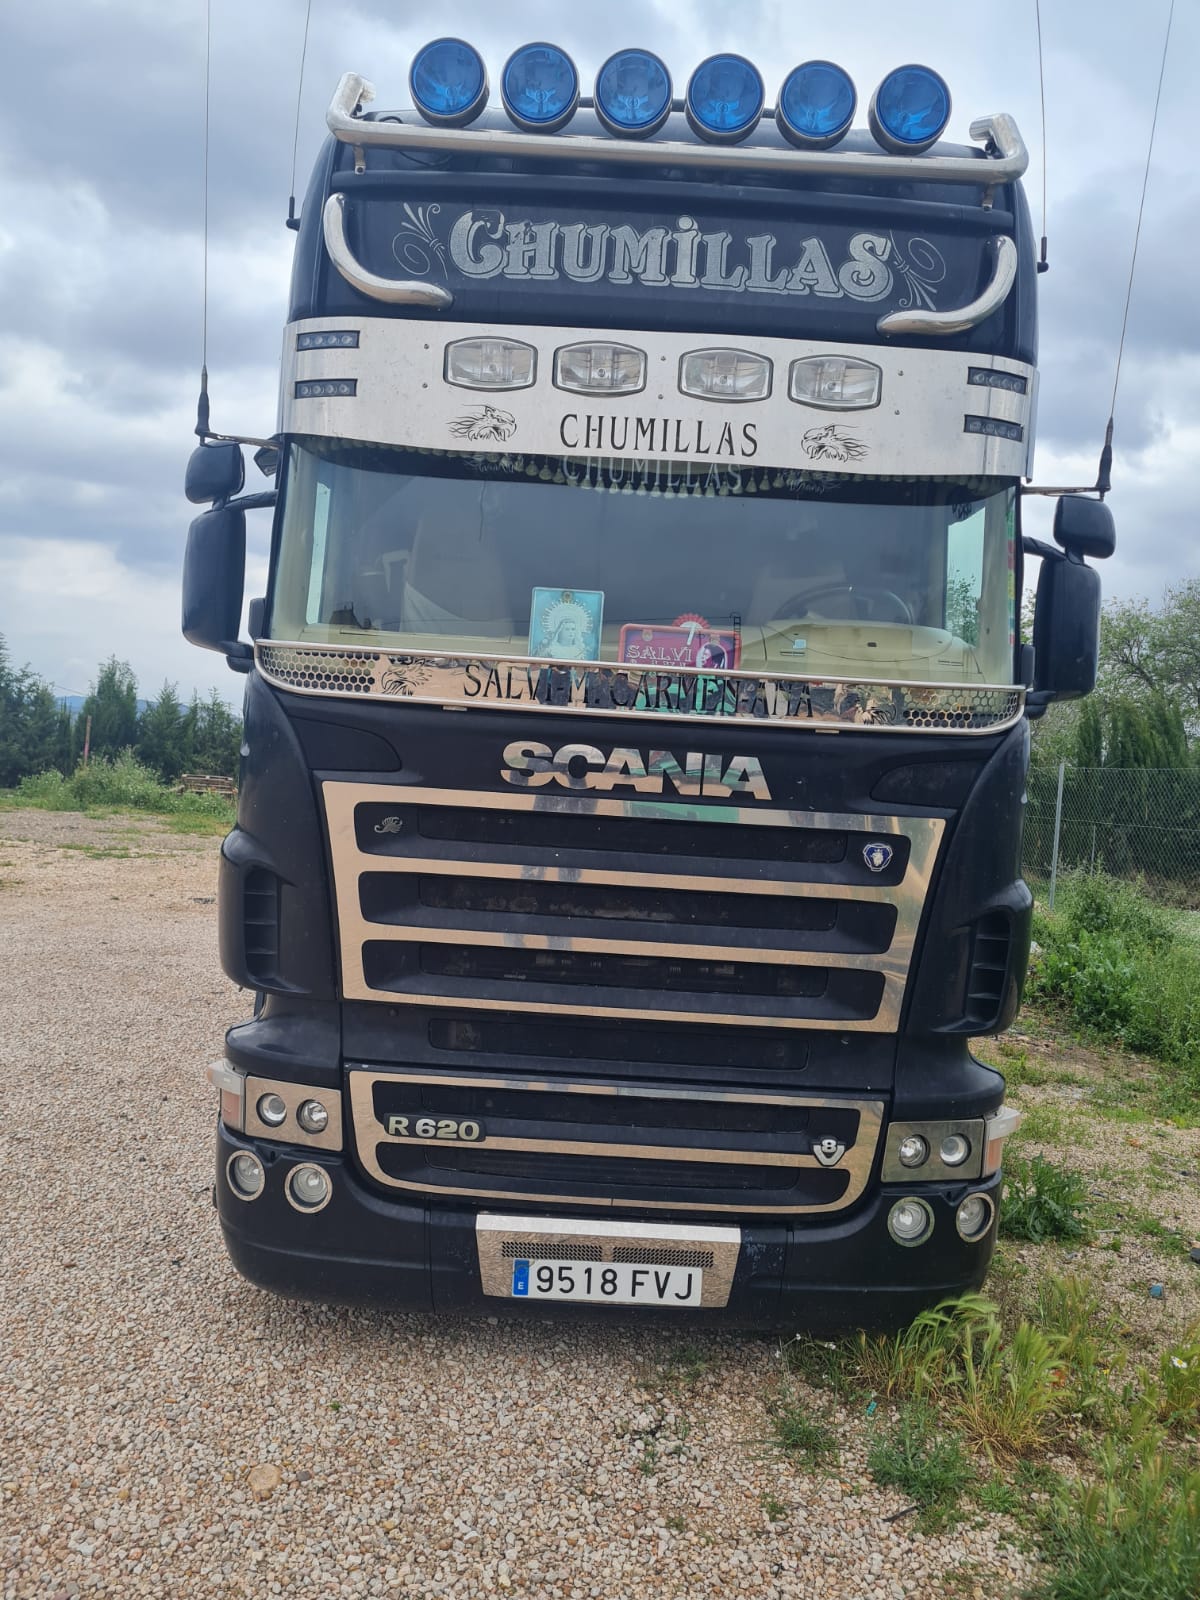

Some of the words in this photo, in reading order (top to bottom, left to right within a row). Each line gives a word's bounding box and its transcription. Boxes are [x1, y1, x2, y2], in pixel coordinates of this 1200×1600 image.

[559, 413, 758, 458] CHUMILLAS
[626, 645, 692, 662] SALVI
[499, 740, 772, 800] SCANIA
[388, 1116, 409, 1136] R
[415, 1118, 480, 1141] 620
[517, 1281, 525, 1291] E
[536, 1265, 618, 1296] 9518
[631, 1269, 693, 1300] FVJ
